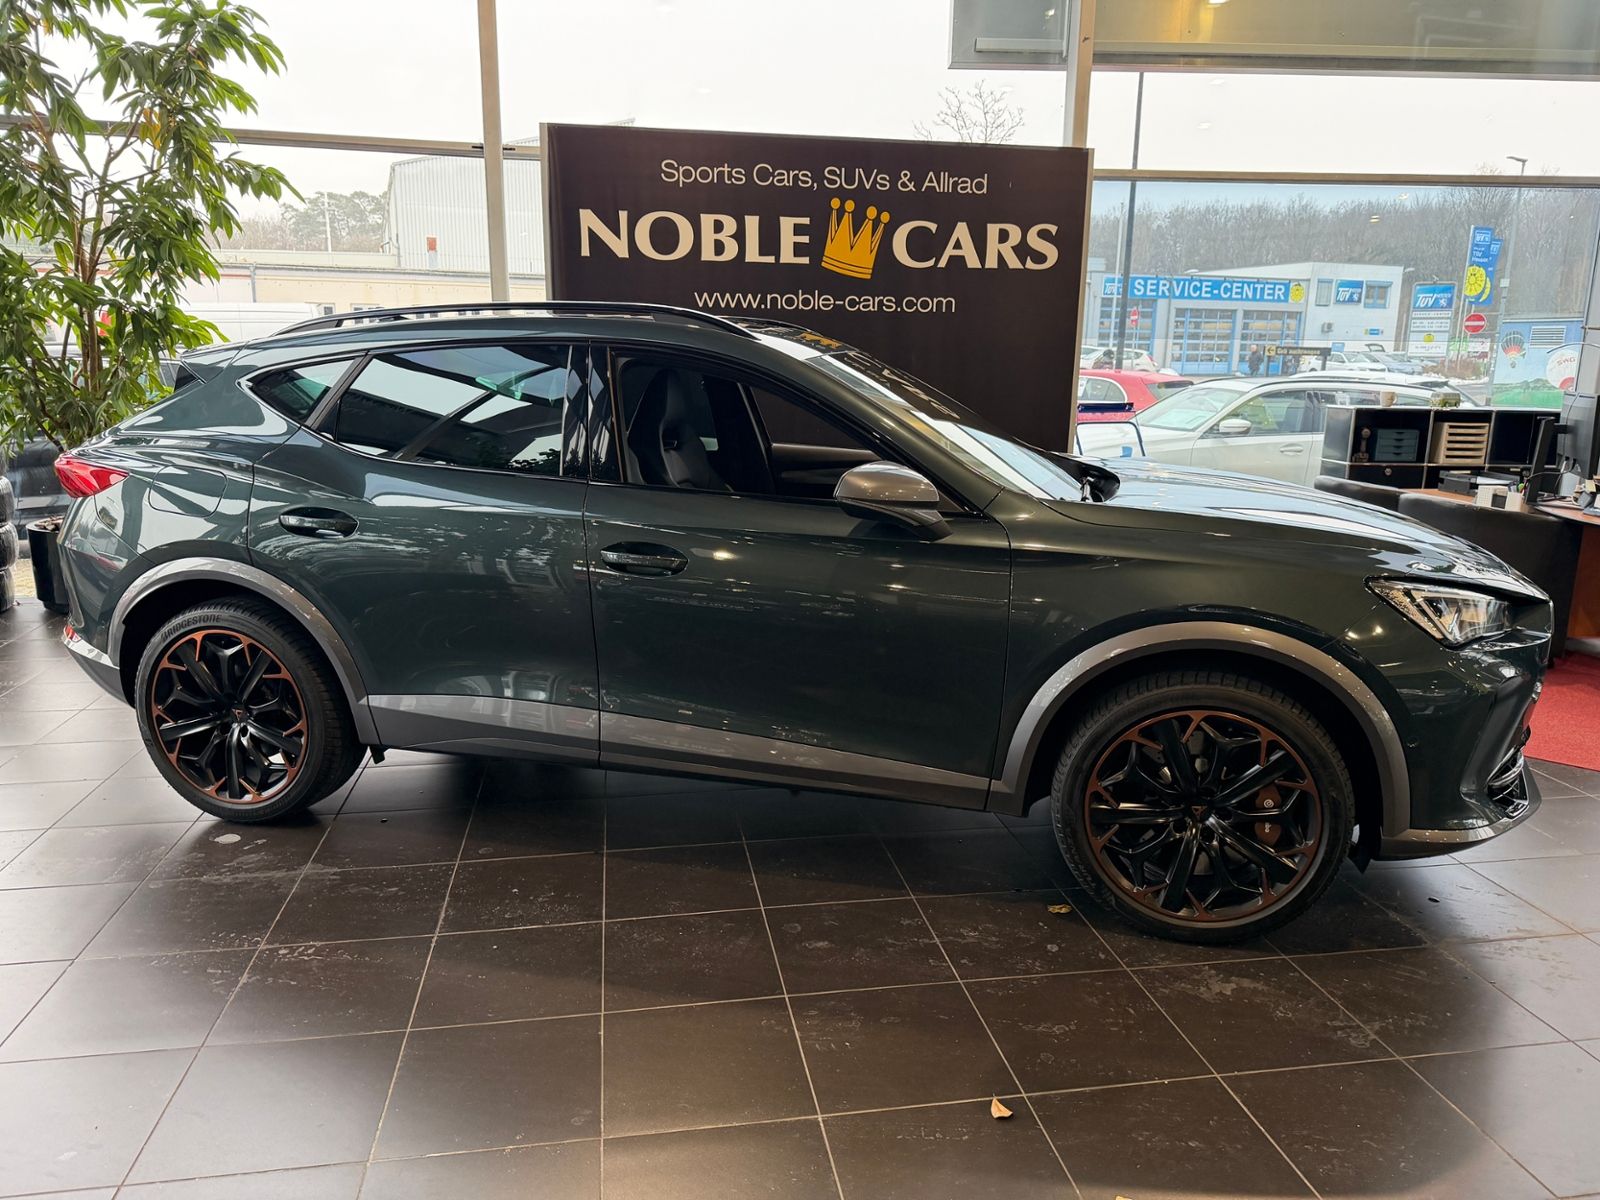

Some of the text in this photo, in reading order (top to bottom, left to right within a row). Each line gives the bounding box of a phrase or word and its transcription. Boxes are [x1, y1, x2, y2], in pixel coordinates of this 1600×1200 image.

[660, 159, 988, 194] Sports Cars, SUVs & Allrad
[579, 208, 1059, 270] NOBLE CARS
[694, 289, 956, 313] www.noble-cars.com
[1133, 279, 1285, 300] SERVICE-CENTER
[160, 614, 223, 643] BRIDGESTONE
